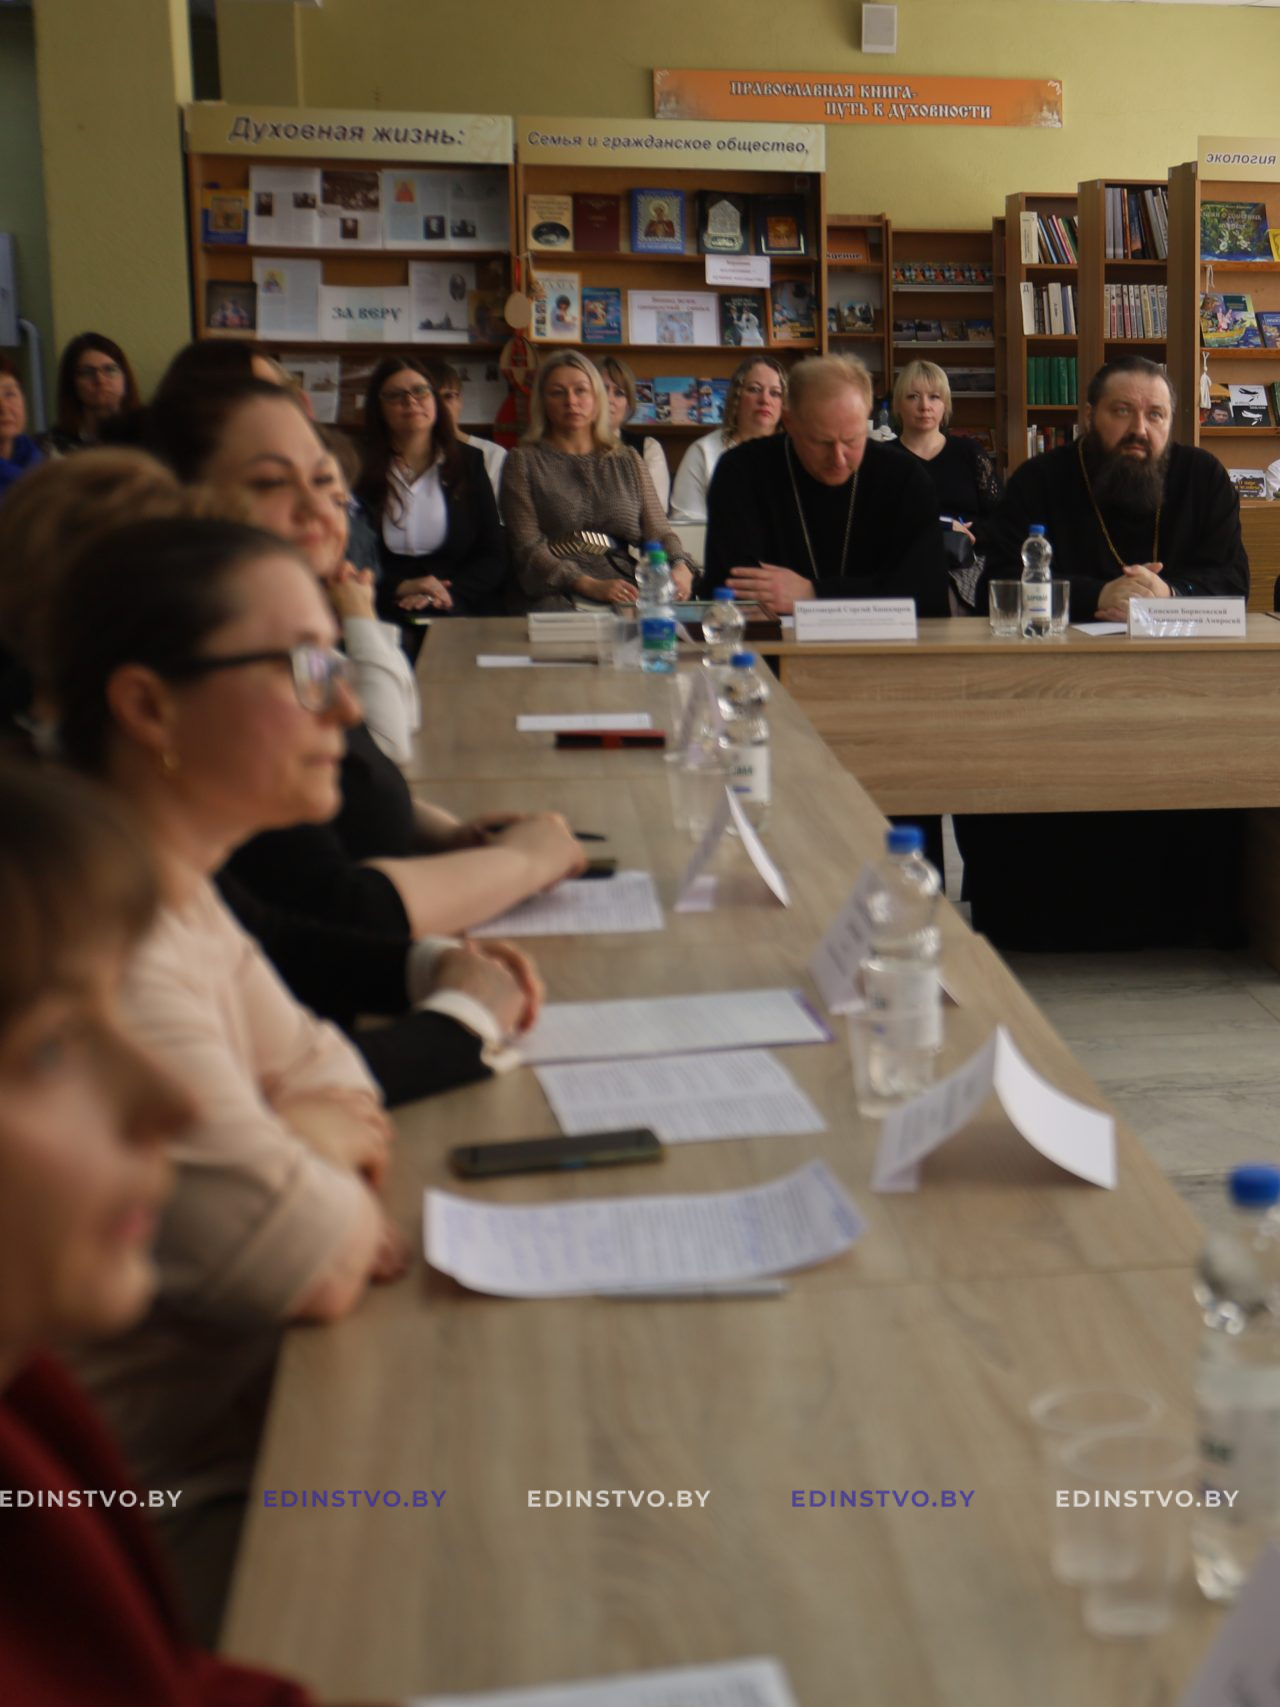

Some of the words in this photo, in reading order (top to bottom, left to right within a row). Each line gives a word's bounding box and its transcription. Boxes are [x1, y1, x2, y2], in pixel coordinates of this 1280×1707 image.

[729, 80, 855, 98] ПРАВОСЛАВНАЯ
[825, 101, 869, 120] ПУТЬ
[873, 103, 884, 117] К
[888, 103, 992, 120] ДУХОВНОСТИ
[228, 116, 365, 142] Духовная
[372, 125, 466, 145] жизнь:
[527, 131, 583, 146] Семья
[588, 136, 598, 146] и
[602, 134, 712, 152] гражданское
[716, 136, 809, 154] общество,
[1206, 153, 1277, 166] экология
